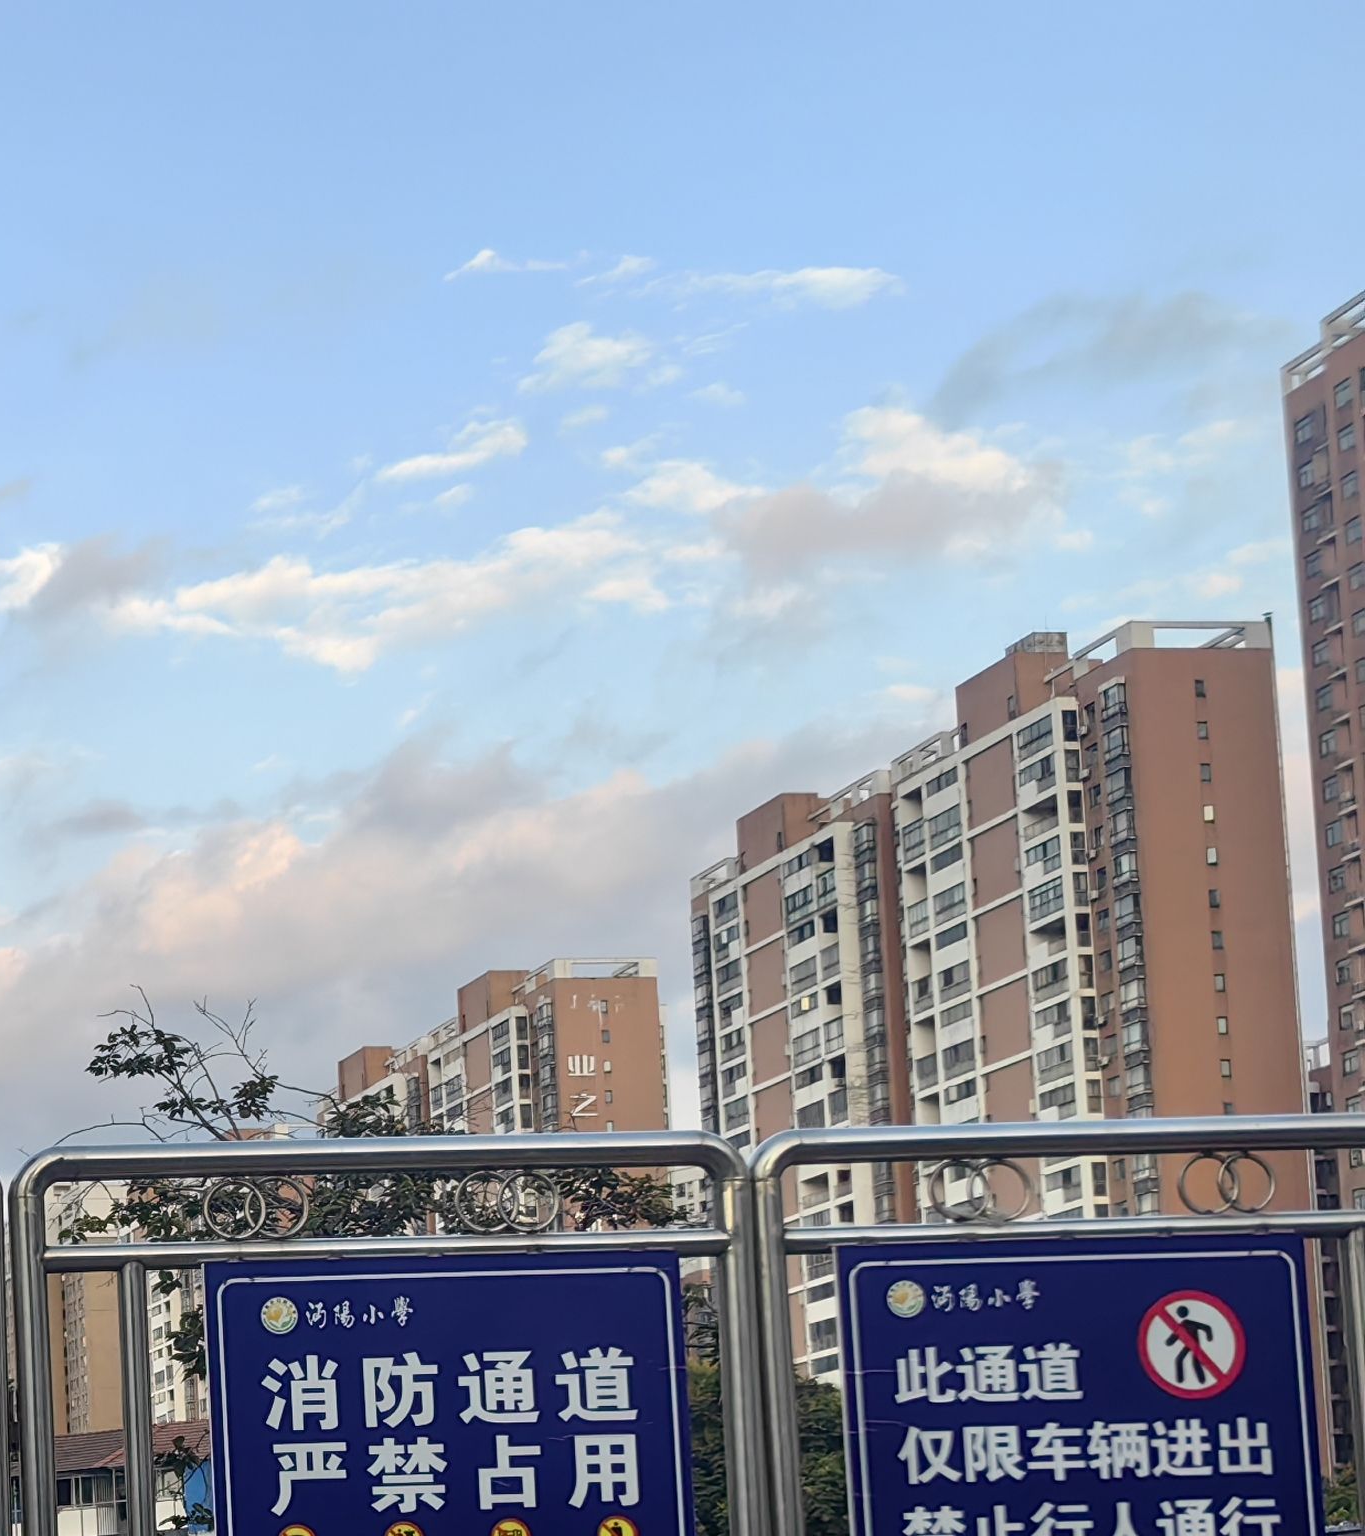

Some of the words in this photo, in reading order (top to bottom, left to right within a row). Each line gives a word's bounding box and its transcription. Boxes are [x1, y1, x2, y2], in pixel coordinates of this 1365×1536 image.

[261, 1347, 638, 1430] 消防通道
[895, 1342, 1084, 1404] 此通道
[271, 1434, 641, 1516] 严禁占用
[898, 1417, 1274, 1485] 仅限车辆进出
